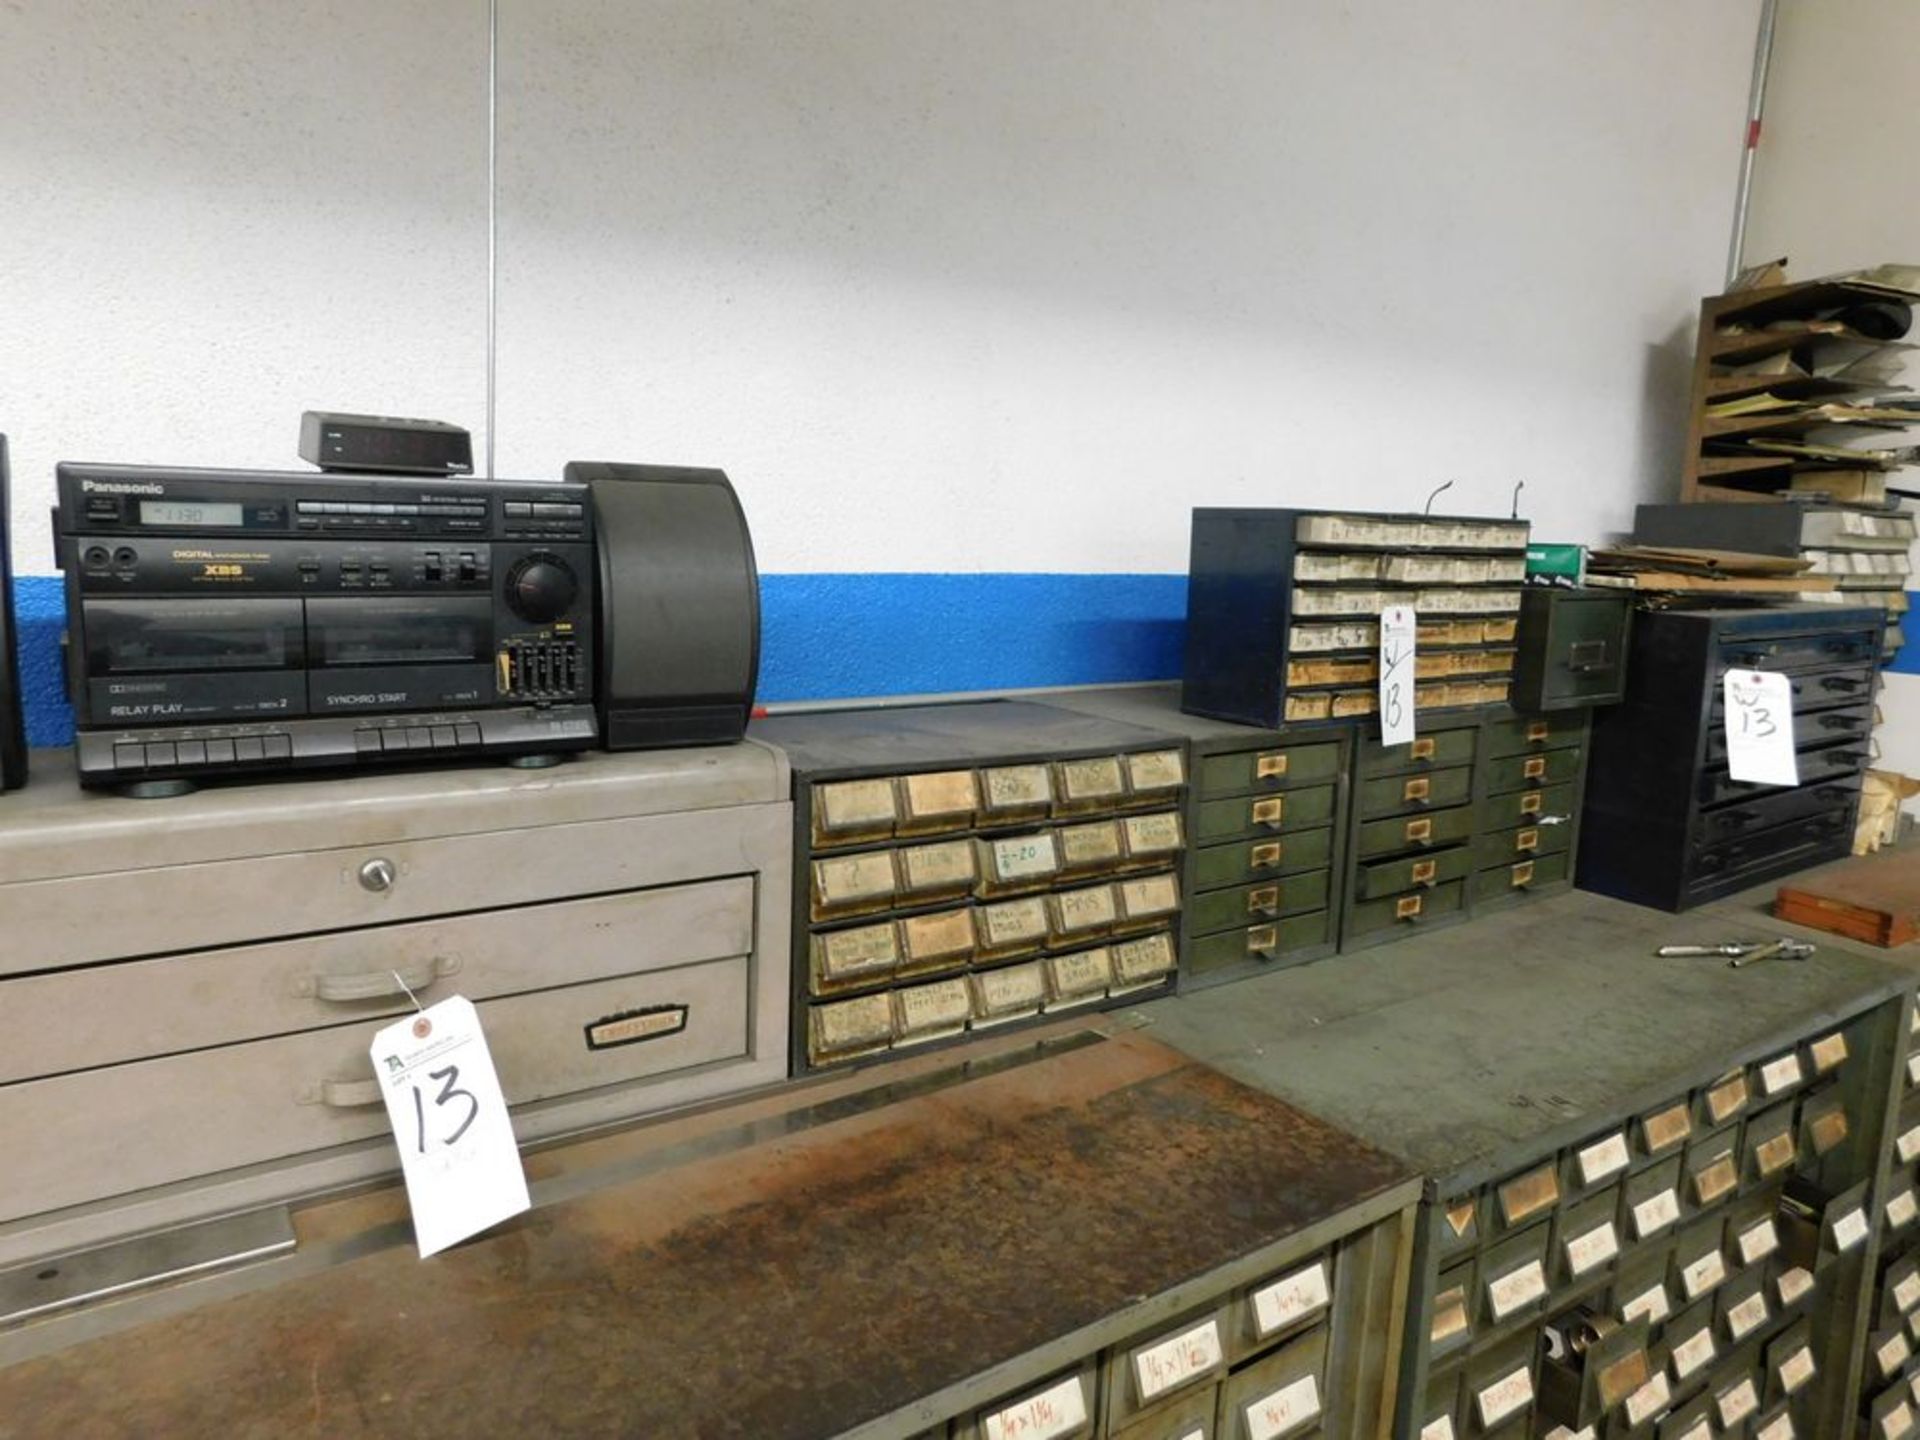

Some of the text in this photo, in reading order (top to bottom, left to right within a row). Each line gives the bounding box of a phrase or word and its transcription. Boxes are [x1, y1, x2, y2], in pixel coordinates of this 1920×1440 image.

[82, 480, 164, 495] Panasonic
[173, 549, 212, 559] DIGITAL
[327, 692, 408, 705] SYNCHRO START
[1384, 682, 1403, 729] 13
[110, 705, 148, 716] RELAY
[152, 703, 182, 714] PLAY
[1742, 708, 1777, 738] 13
[411, 1064, 480, 1153] 13
